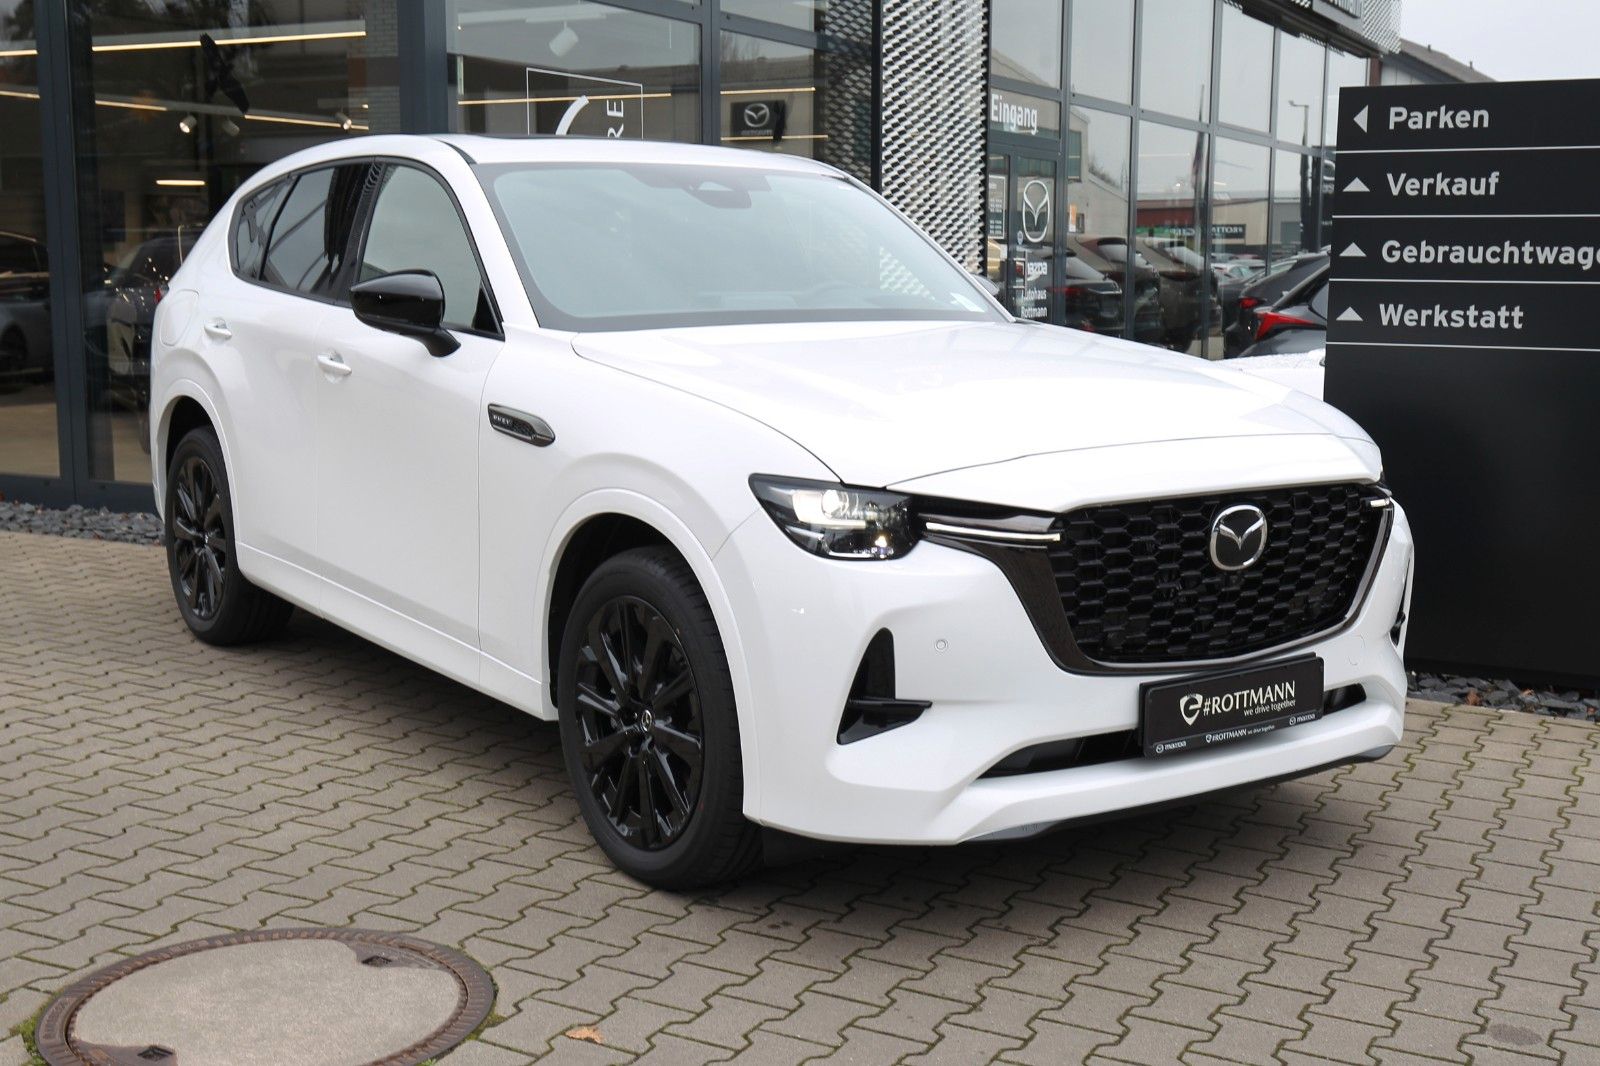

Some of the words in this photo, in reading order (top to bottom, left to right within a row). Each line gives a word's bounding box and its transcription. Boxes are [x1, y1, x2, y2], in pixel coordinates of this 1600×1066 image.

[991, 93, 1038, 135] Eingang
[1388, 104, 1489, 130] Parken
[1386, 171, 1500, 196] Verkauf
[1379, 303, 1524, 330] Werkstatt
[1203, 680, 1296, 717] #ROTTMANN
[1243, 708, 1254, 717] we
[1254, 704, 1270, 715] drive
[1271, 699, 1296, 712] together
